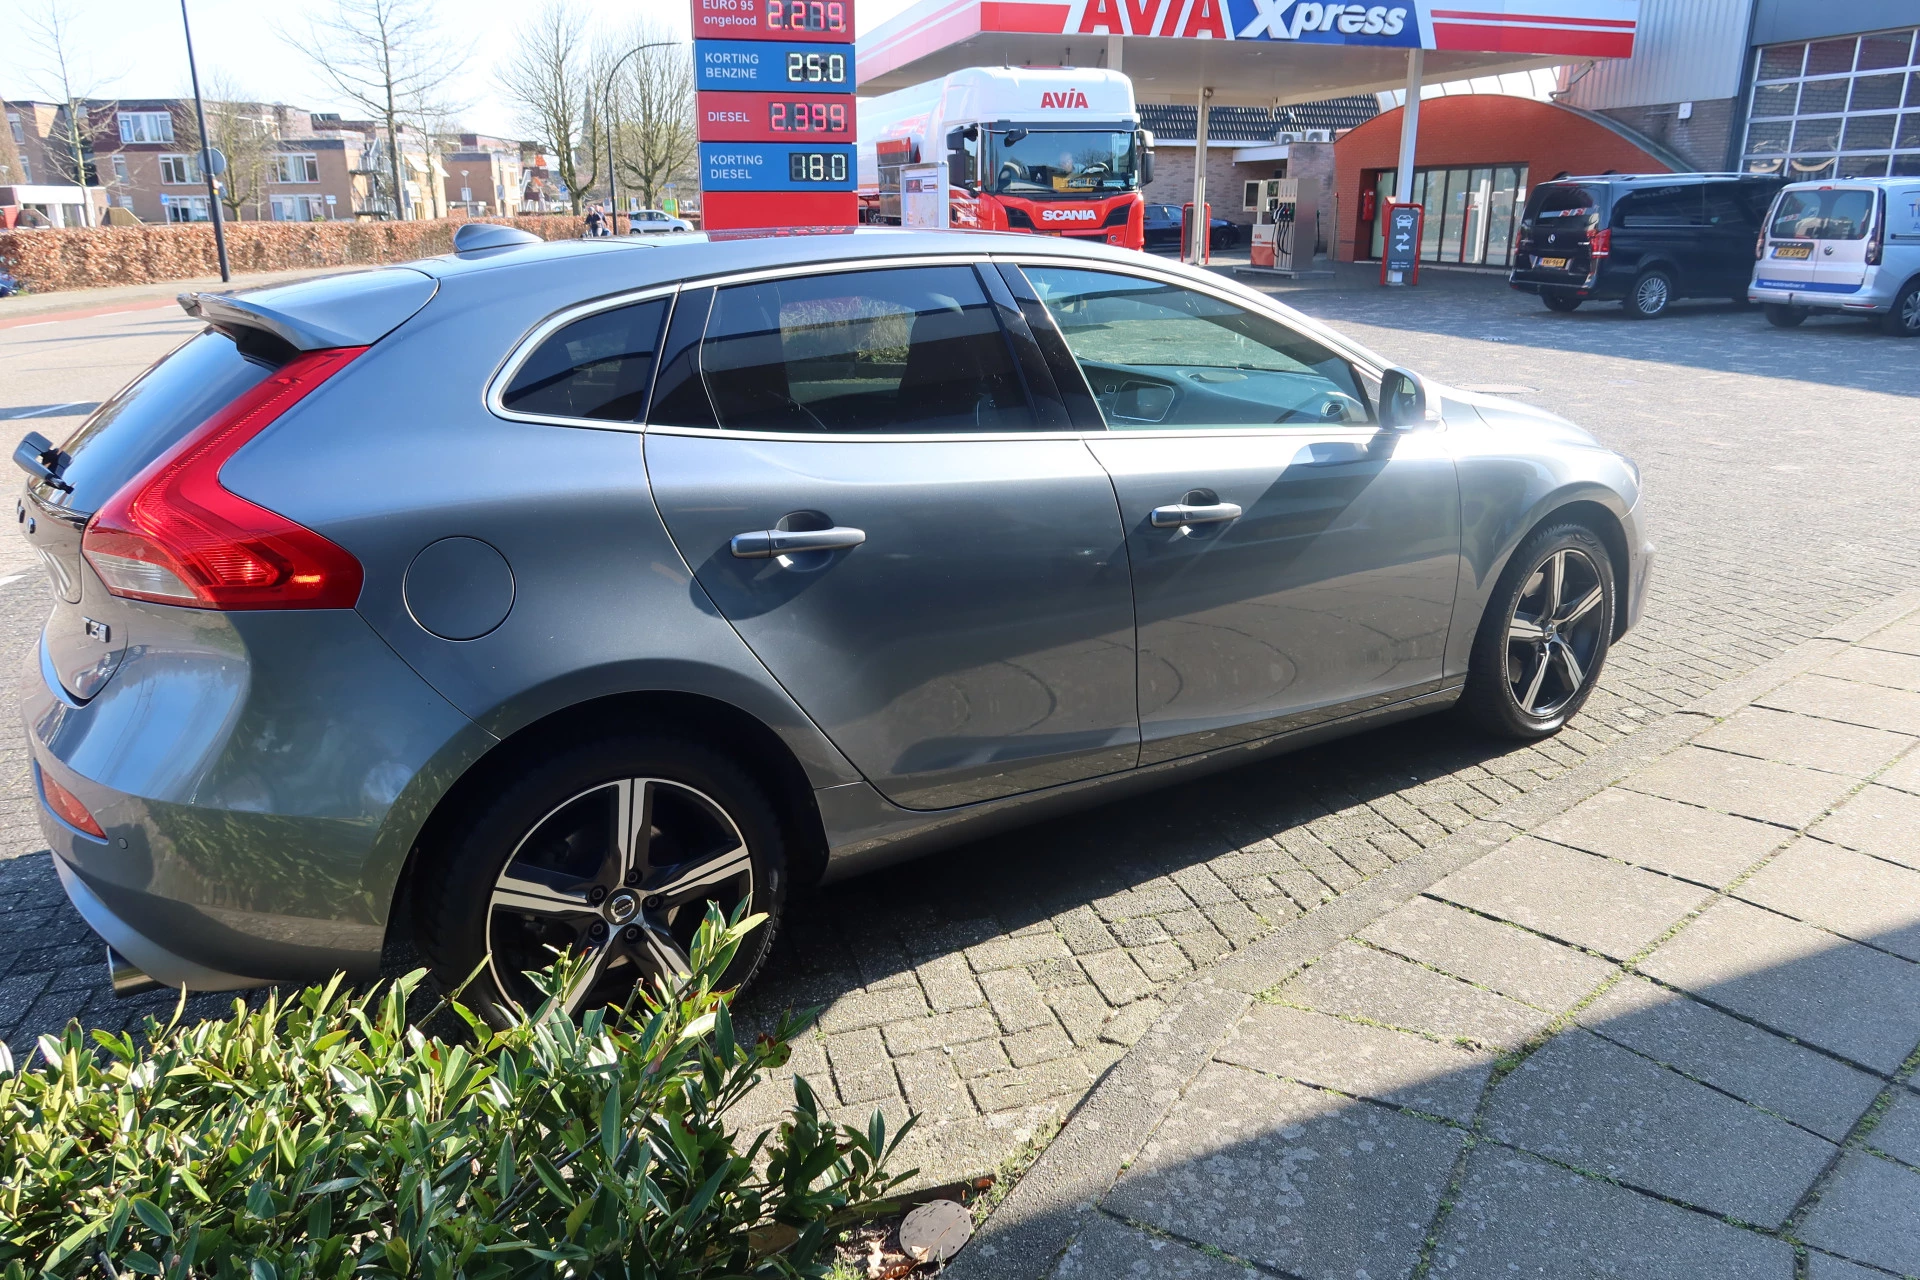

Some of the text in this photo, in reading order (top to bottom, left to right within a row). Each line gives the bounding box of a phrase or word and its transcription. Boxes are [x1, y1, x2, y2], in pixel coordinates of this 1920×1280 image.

[703, 0, 754, 11] EURO 95
[703, 15, 757, 26] ongelood
[768, 1, 844, 31] 2.279
[1078, 0, 1408, 40] AVIA Xpress
[705, 53, 759, 64] KORTING
[788, 53, 844, 82] 25.0
[705, 68, 757, 79] BENZINE
[1040, 88, 1089, 109] AVIA
[708, 111, 750, 122] DIESEL
[771, 103, 845, 131] 2.399
[710, 155, 763, 165] KORTING
[801, 154, 846, 181] 18.0
[711, 169, 752, 179] DIESEL
[1042, 209, 1097, 221] SCANIA
